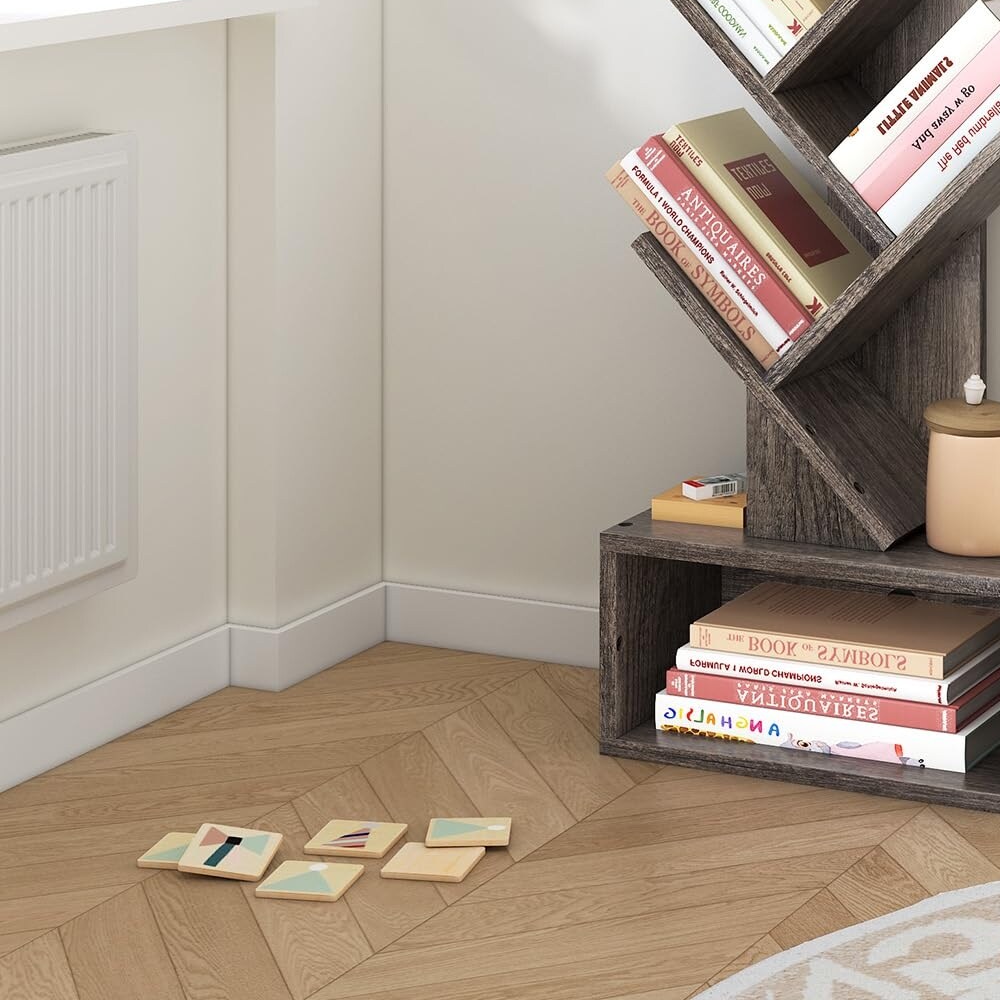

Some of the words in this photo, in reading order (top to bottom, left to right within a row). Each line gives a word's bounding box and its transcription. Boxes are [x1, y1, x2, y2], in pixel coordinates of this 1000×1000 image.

[631, 165, 660, 199] FORMULA
[661, 201, 683, 227] WORLD
[681, 224, 715, 265] CHAMPIONS
[680, 187, 767, 286] ANTIQUAIRES
[631, 198, 646, 216] THE
[646, 209, 686, 263] BOOK
[681, 257, 691, 268] OF
[690, 264, 756, 341] SYMBOLS
